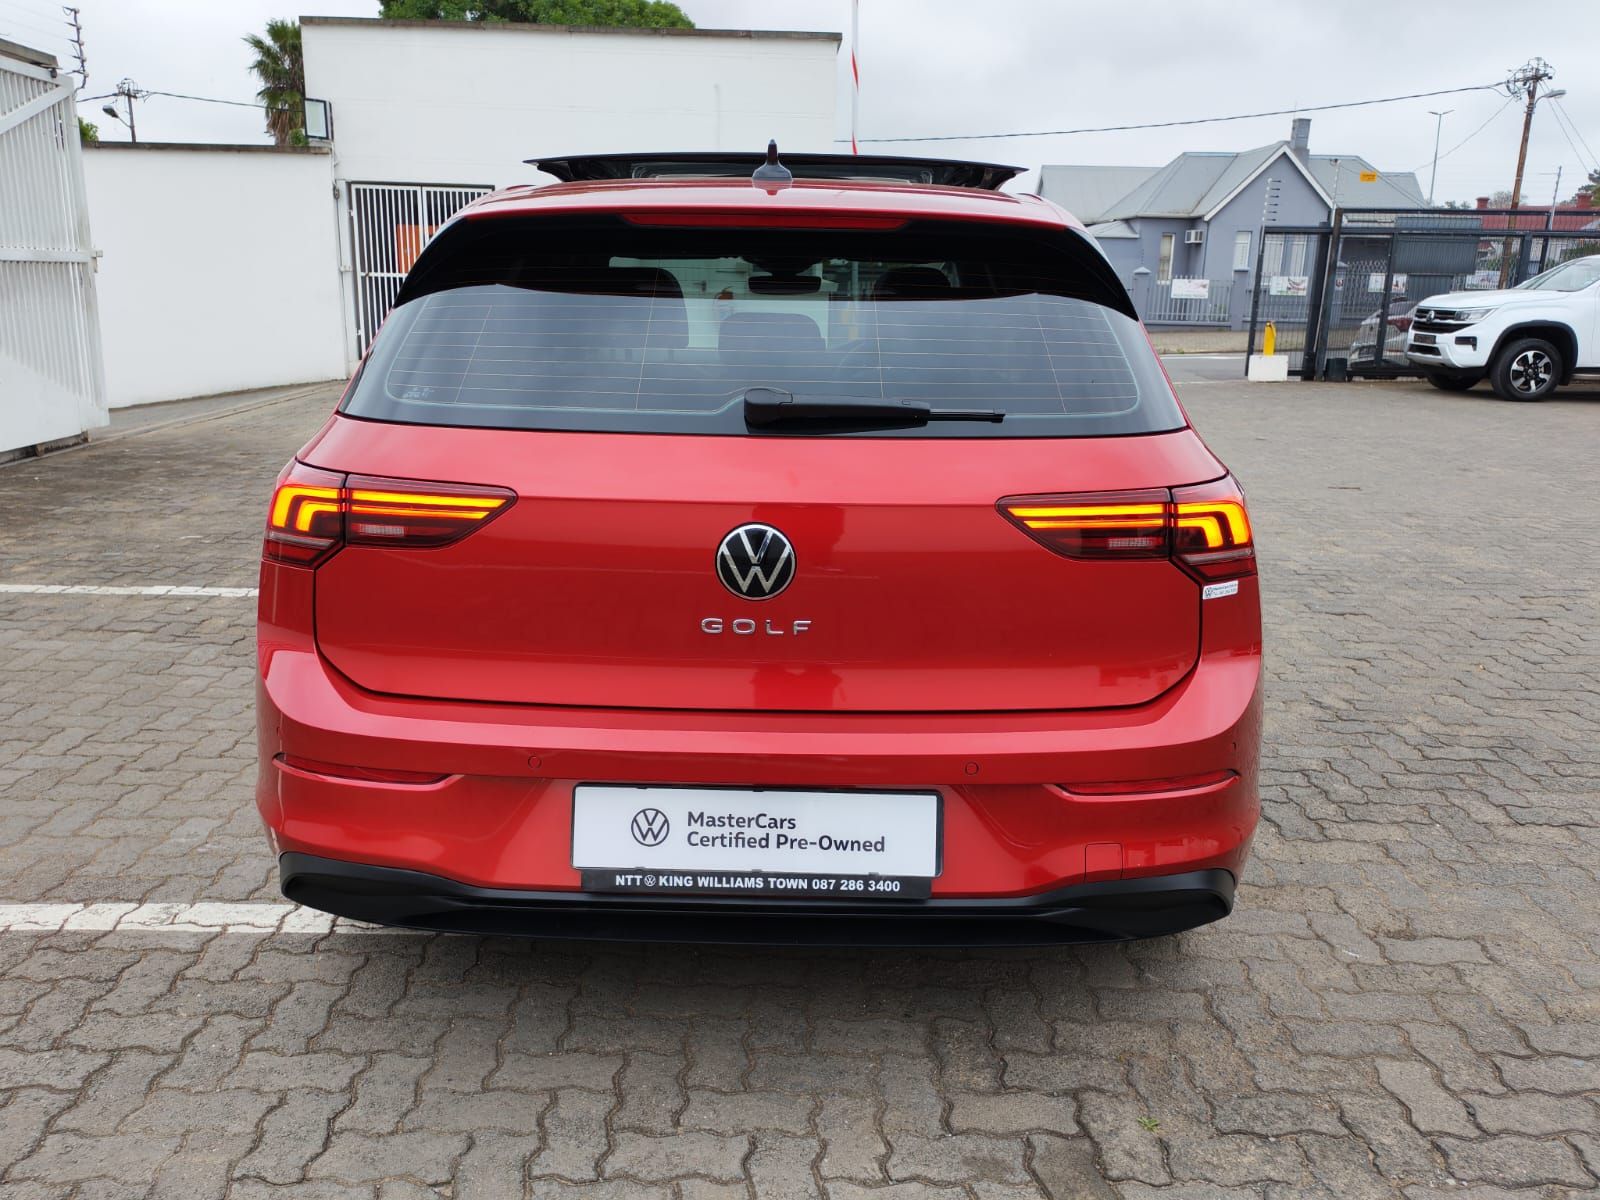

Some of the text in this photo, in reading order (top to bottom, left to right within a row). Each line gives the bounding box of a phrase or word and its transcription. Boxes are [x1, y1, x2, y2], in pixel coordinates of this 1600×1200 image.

[701, 617, 812, 635] GOLF
[687, 811, 797, 830] MasterCars
[686, 831, 886, 853] Certified Pre-Owned
[615, 875, 643, 886] NTT
[659, 876, 693, 887] KING
[697, 876, 764, 889] WILLIAMS
[768, 877, 808, 890] TOWN
[812, 879, 836, 890] 087
[840, 880, 864, 891] 286
[868, 880, 900, 892] 3400
